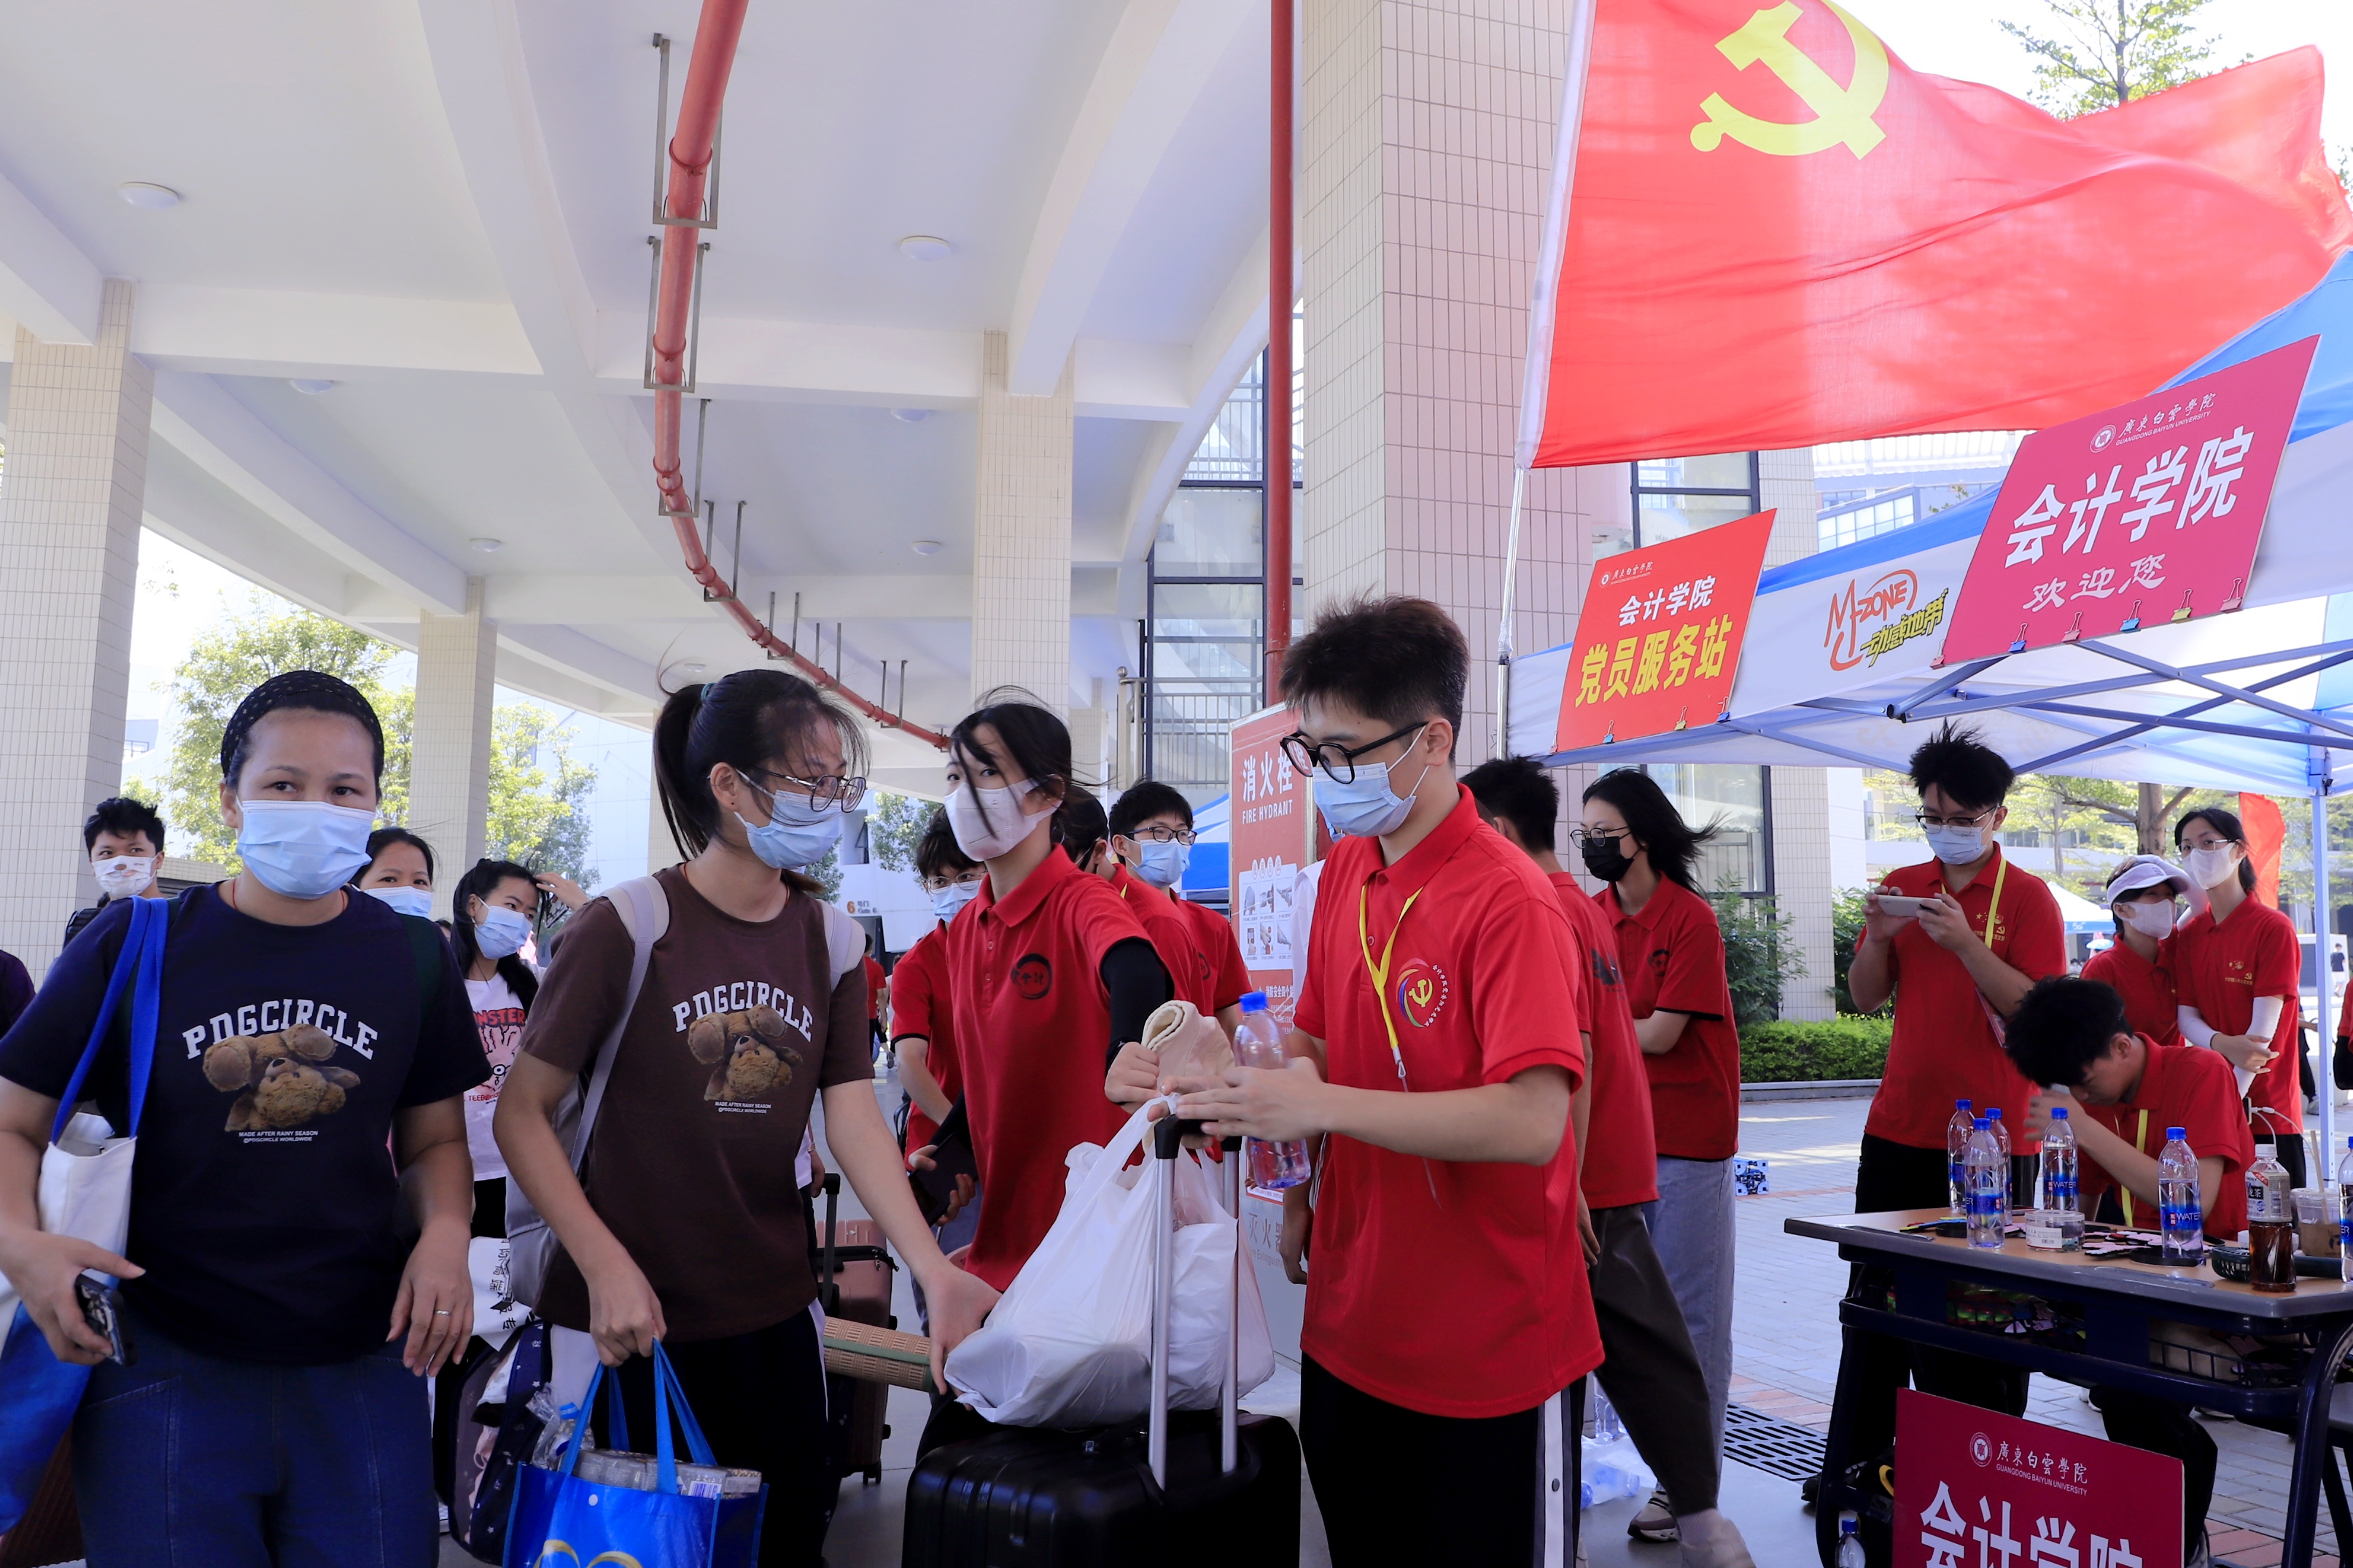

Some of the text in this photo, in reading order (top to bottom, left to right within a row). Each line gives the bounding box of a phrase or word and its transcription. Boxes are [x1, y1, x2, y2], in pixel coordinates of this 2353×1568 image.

[2116, 430, 2152, 446] GUANGDONG
[2153, 423, 2175, 435] BAIYUN
[2175, 410, 2212, 428] UNIVERSITY
[2004, 425, 2255, 569] 会计学院
[1618, 574, 1716, 627] 会计学院
[2022, 553, 2166, 613] 欢迎您
[1859, 588, 1949, 668] 动感地带
[1574, 613, 1733, 709] 党员服务站
[1242, 746, 1293, 803] 消火栓
[1242, 799, 1293, 824] FIRE HYDRANT
[847, 901, 855, 914] 6
[472, 1007, 526, 1026] NSTER
[2053, 1181, 2077, 1189] WATER
[1996, 1440, 2088, 1484] 廣東白雲學院
[1996, 1463, 2088, 1497] GUANGDONG BAIYUN UNIVERSITY
